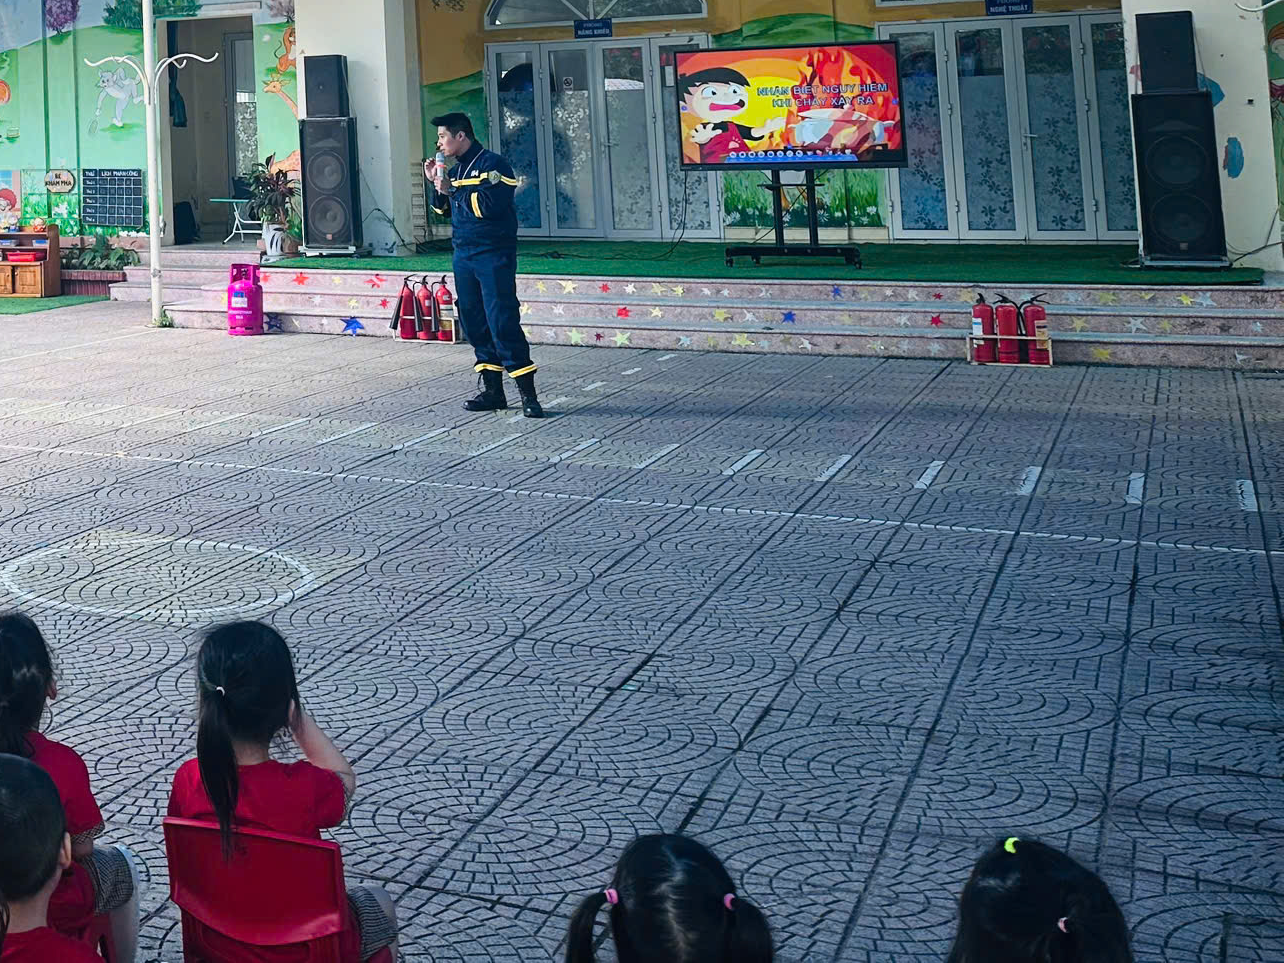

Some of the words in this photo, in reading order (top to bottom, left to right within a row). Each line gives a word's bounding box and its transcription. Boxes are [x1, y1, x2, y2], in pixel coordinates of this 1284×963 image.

[822, 84, 856, 94] NGUY
[772, 98, 792, 108] KHI
[857, 96, 874, 105] RA
